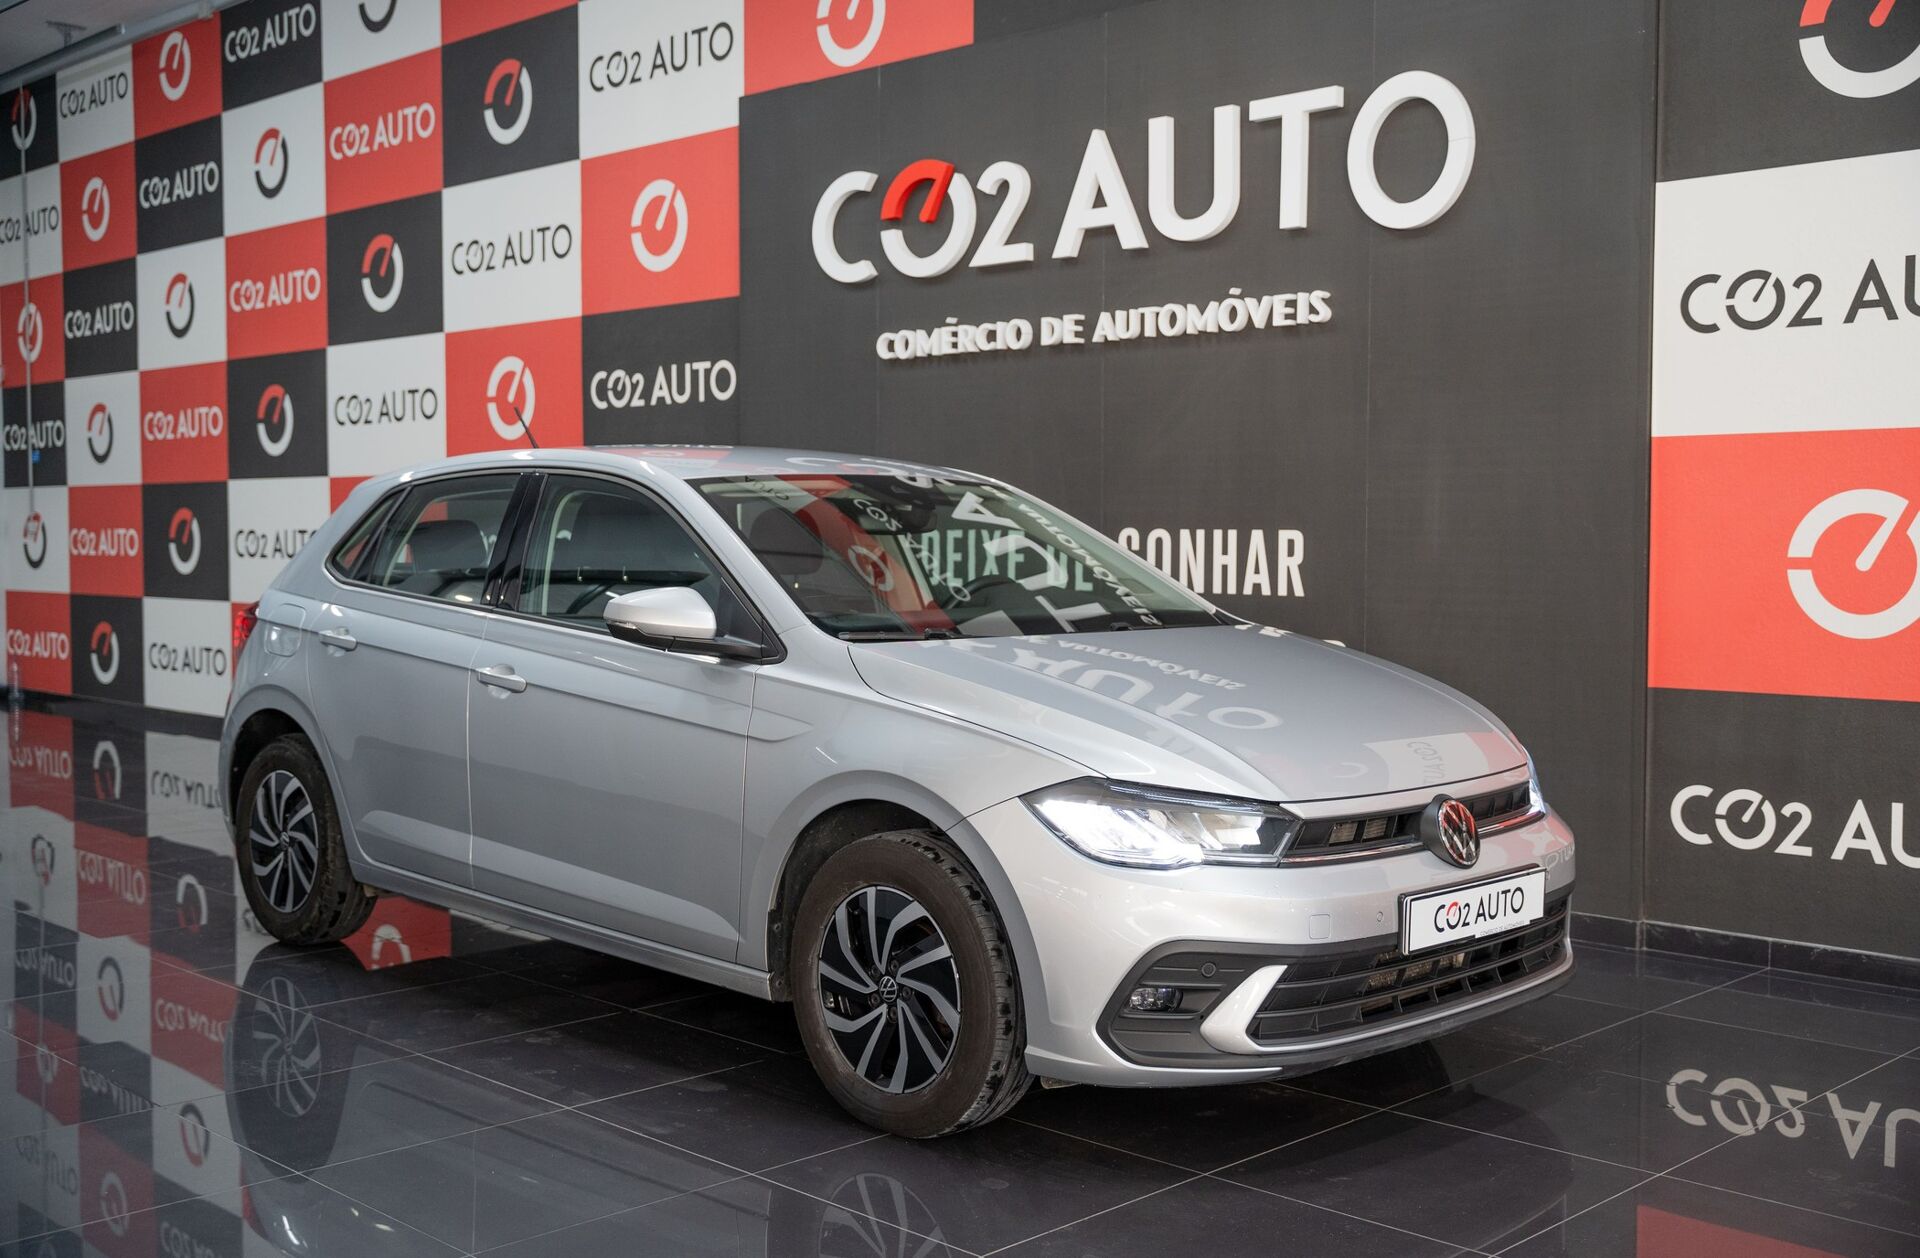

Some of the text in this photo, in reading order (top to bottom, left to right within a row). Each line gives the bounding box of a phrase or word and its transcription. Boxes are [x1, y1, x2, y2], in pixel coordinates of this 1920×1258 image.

[225, 3, 317, 63] CO2 AUTO
[589, 21, 733, 92] CO2 AUTO
[60, 71, 129, 119] CO2 AUTO
[329, 102, 436, 160] CO2 AUTO
[140, 161, 220, 209] CO2 AUTO
[812, 70, 1476, 284] CO2 AUTO
[452, 224, 573, 275] CO2 AUTO
[229, 268, 321, 313] CO2 AUTO
[1680, 269, 1824, 334] CO2
[65, 301, 135, 339] CO2 AUTO
[876, 287, 1332, 360] COMÉRCIO DE AUTOMÓVEIS
[334, 388, 438, 427] CO2 AUTO
[589, 359, 738, 410] CO2 AUTO
[3, 419, 65, 451] CO2 AUTO
[143, 406, 224, 442] CO2 AUTO
[69, 528, 139, 558] CO2 AUTO
[235, 529, 317, 558] CO2 AUT
[7, 629, 69, 660] CO2 AUTO
[148, 643, 227, 677] CO2 AUTO
[1669, 784, 1814, 857] CO2
[1433, 901, 1471, 933] CO2
[1474, 886, 1525, 925] AUTO
